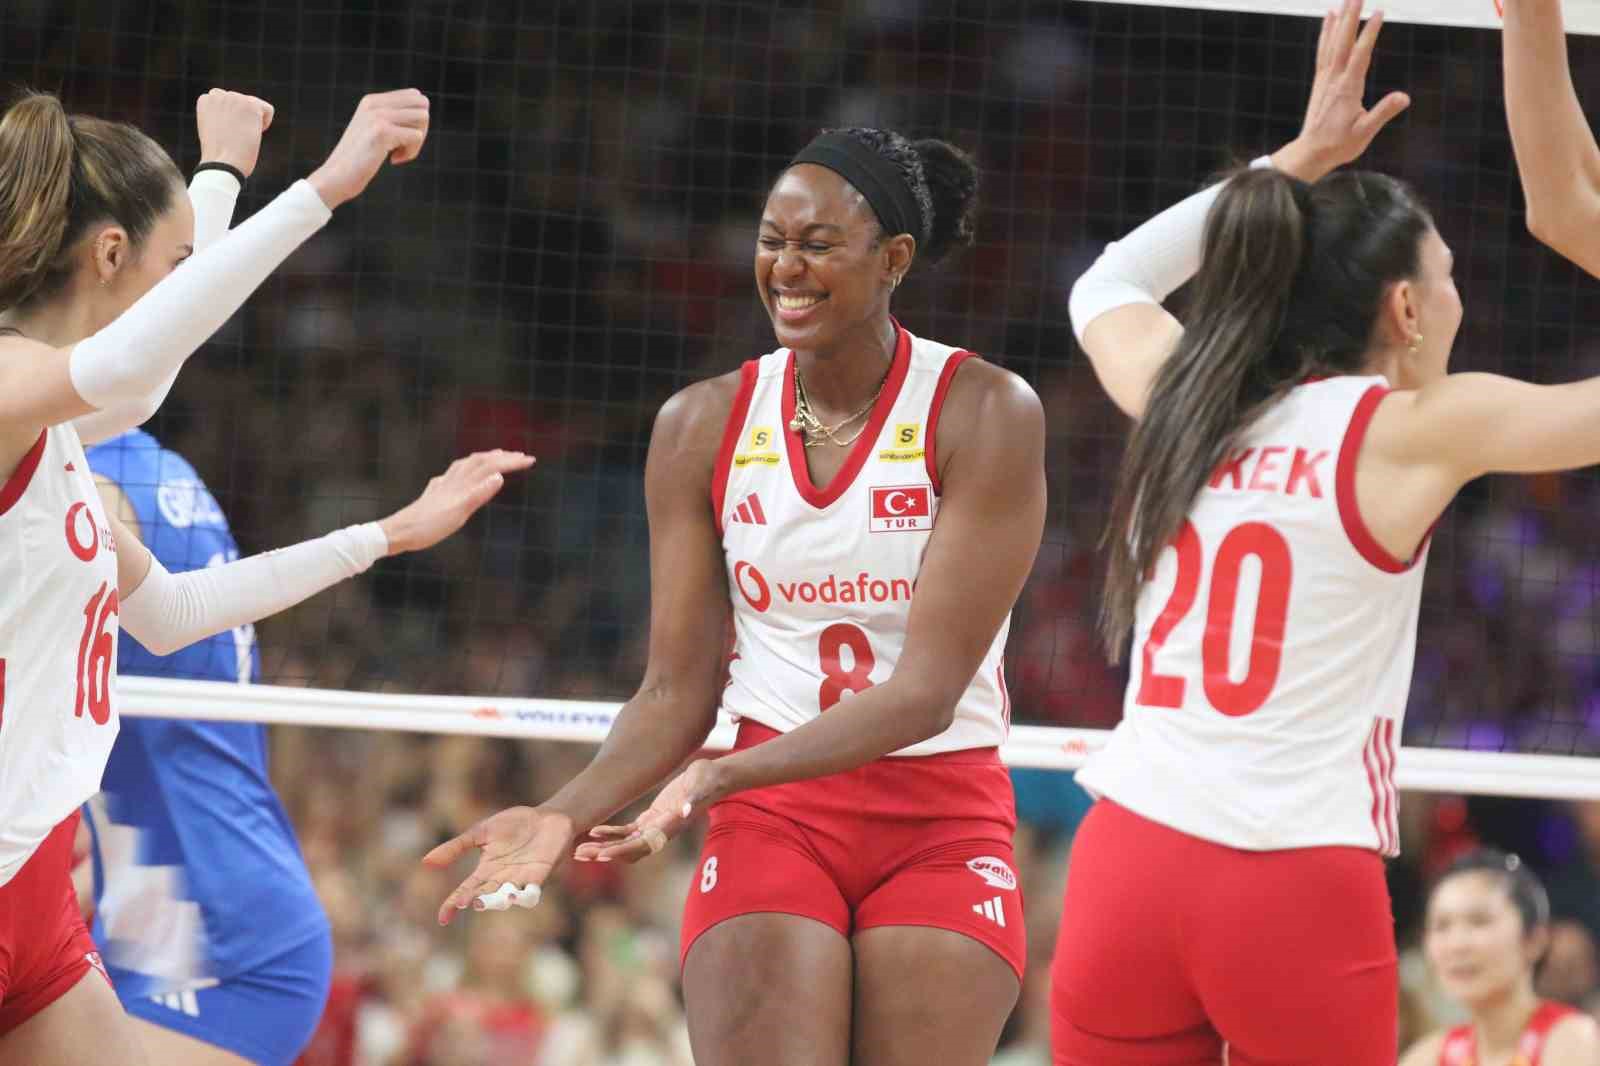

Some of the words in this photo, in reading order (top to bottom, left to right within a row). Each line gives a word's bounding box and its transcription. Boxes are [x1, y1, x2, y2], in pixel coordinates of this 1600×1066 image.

[755, 431, 768, 446] S
[901, 428, 915, 443] S
[1207, 446, 1332, 499] KEK
[884, 518, 917, 529] TUR
[776, 572, 919, 603] vodafon
[1136, 518, 1293, 717] 20
[74, 580, 119, 725] 16
[818, 623, 876, 714] 8
[701, 856, 718, 893] 8
